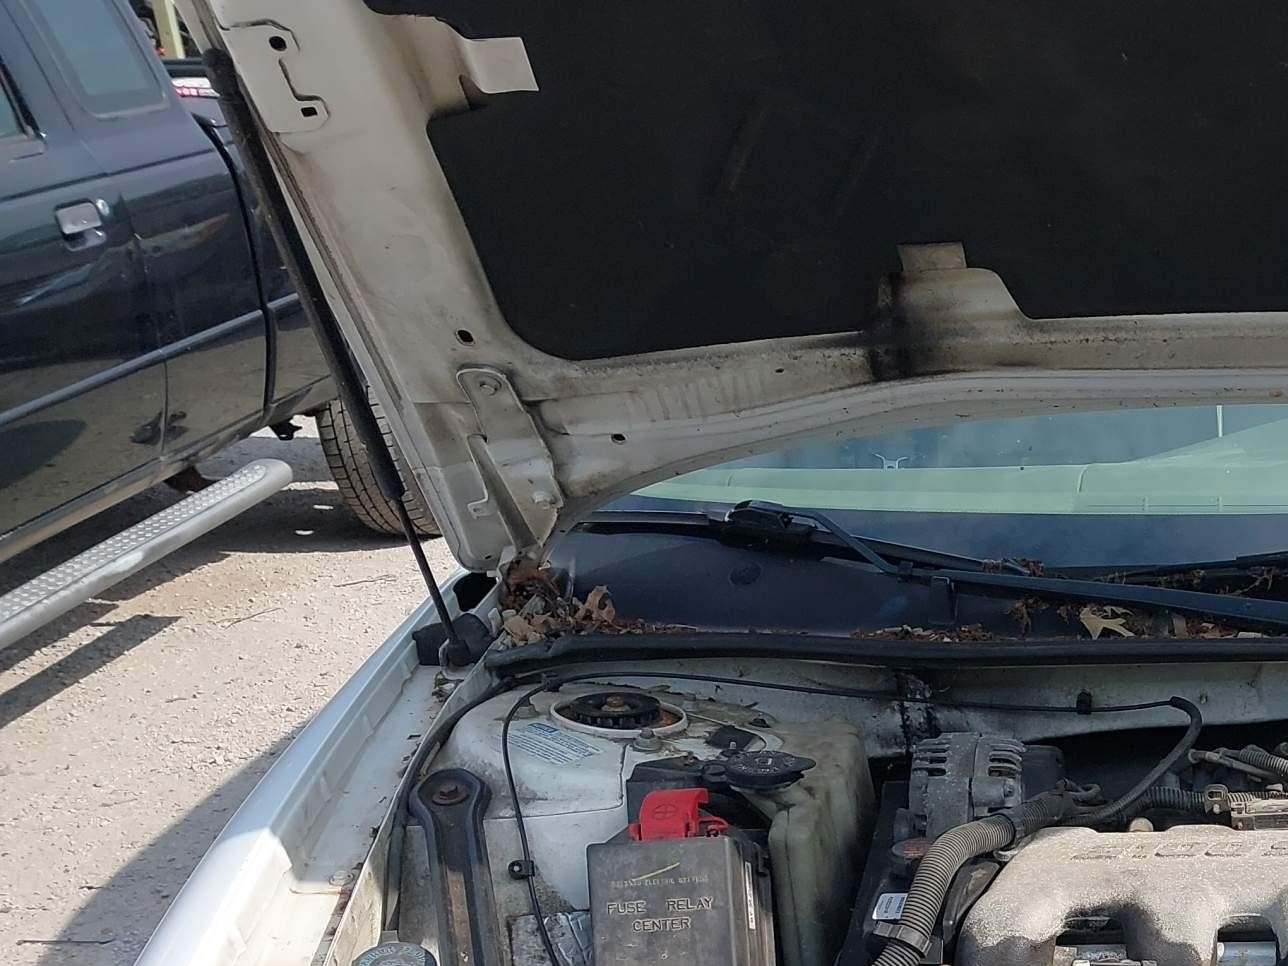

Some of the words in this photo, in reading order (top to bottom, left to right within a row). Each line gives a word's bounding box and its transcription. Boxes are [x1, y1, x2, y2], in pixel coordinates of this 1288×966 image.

[607, 900, 647, 915] FUSE
[666, 896, 714, 912] RELAY
[632, 916, 692, 933] CENTER
